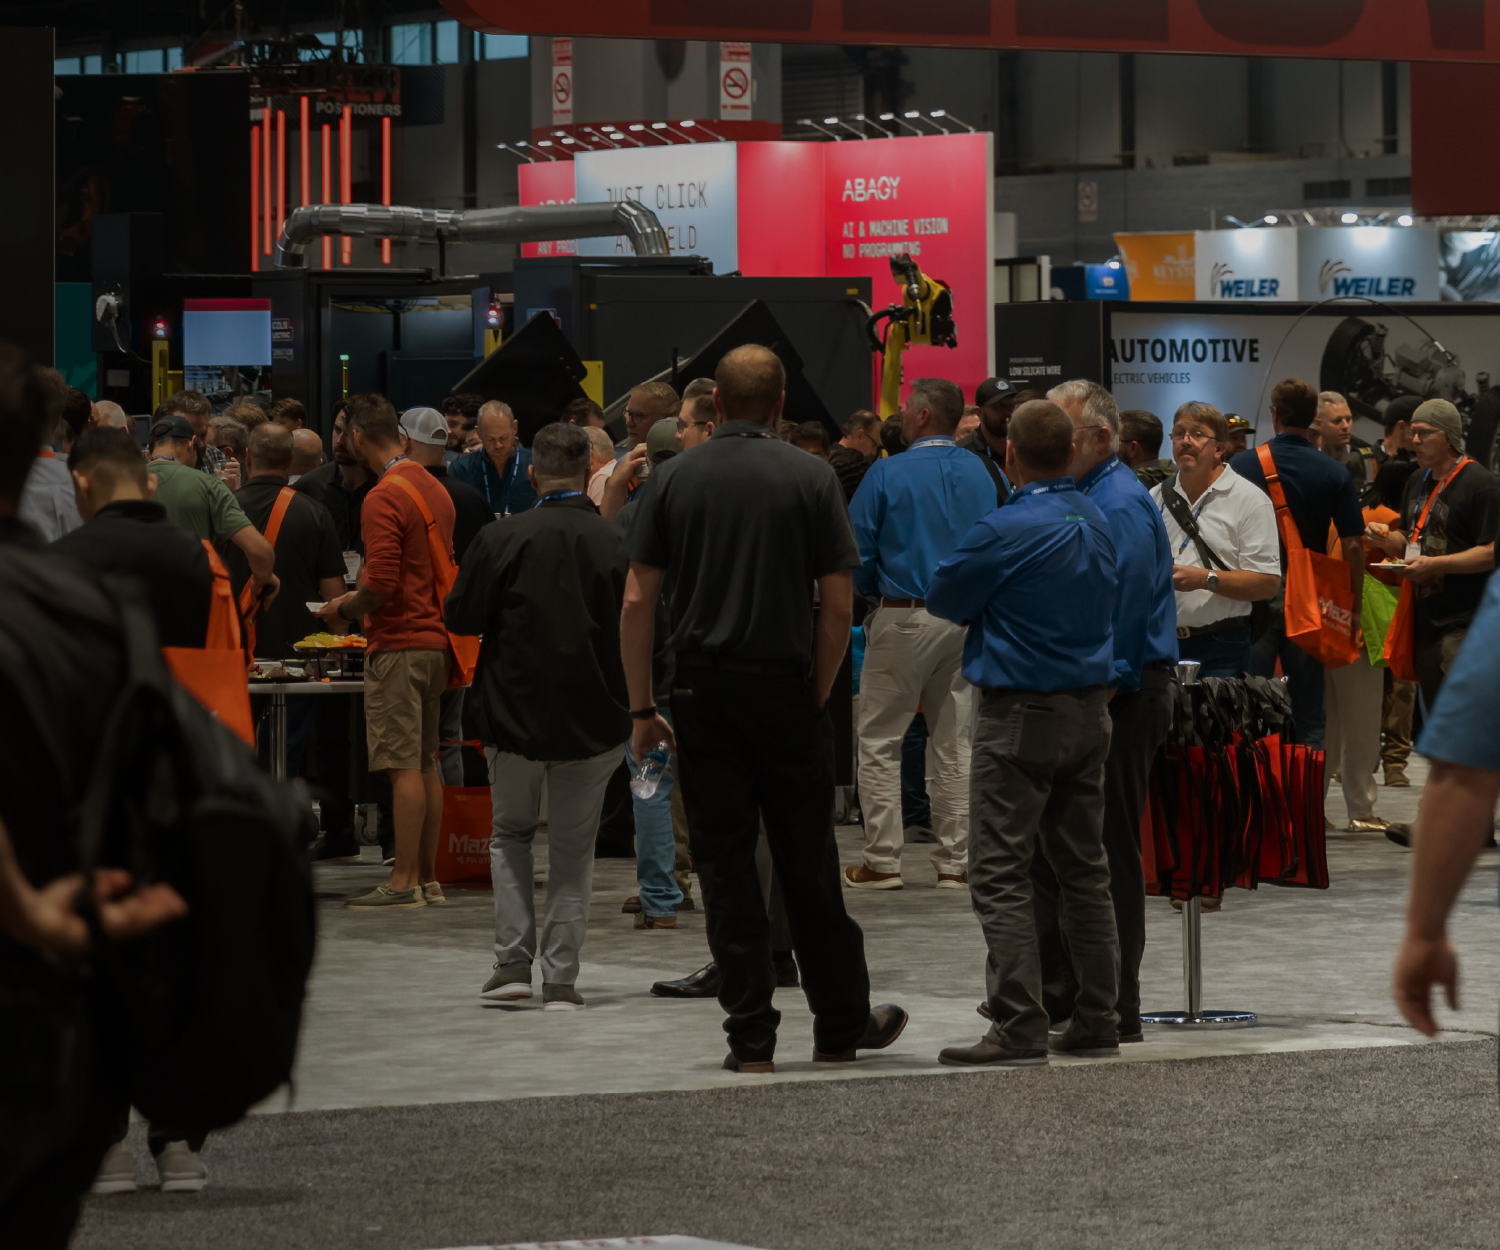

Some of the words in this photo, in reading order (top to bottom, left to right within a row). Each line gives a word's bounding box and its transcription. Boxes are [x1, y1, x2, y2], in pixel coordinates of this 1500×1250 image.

[315, 101, 401, 116] POSIONERS
[656, 181, 708, 210] CLICK
[842, 176, 901, 202] ABAGY
[869, 219, 909, 237] MACHINE
[913, 217, 949, 236] VISION
[1220, 278, 1280, 299] WEILER
[1334, 277, 1416, 296] WEILER
[1111, 338, 1259, 363] AUTOMOTIVE
[1148, 372, 1191, 384] VEHICLES
